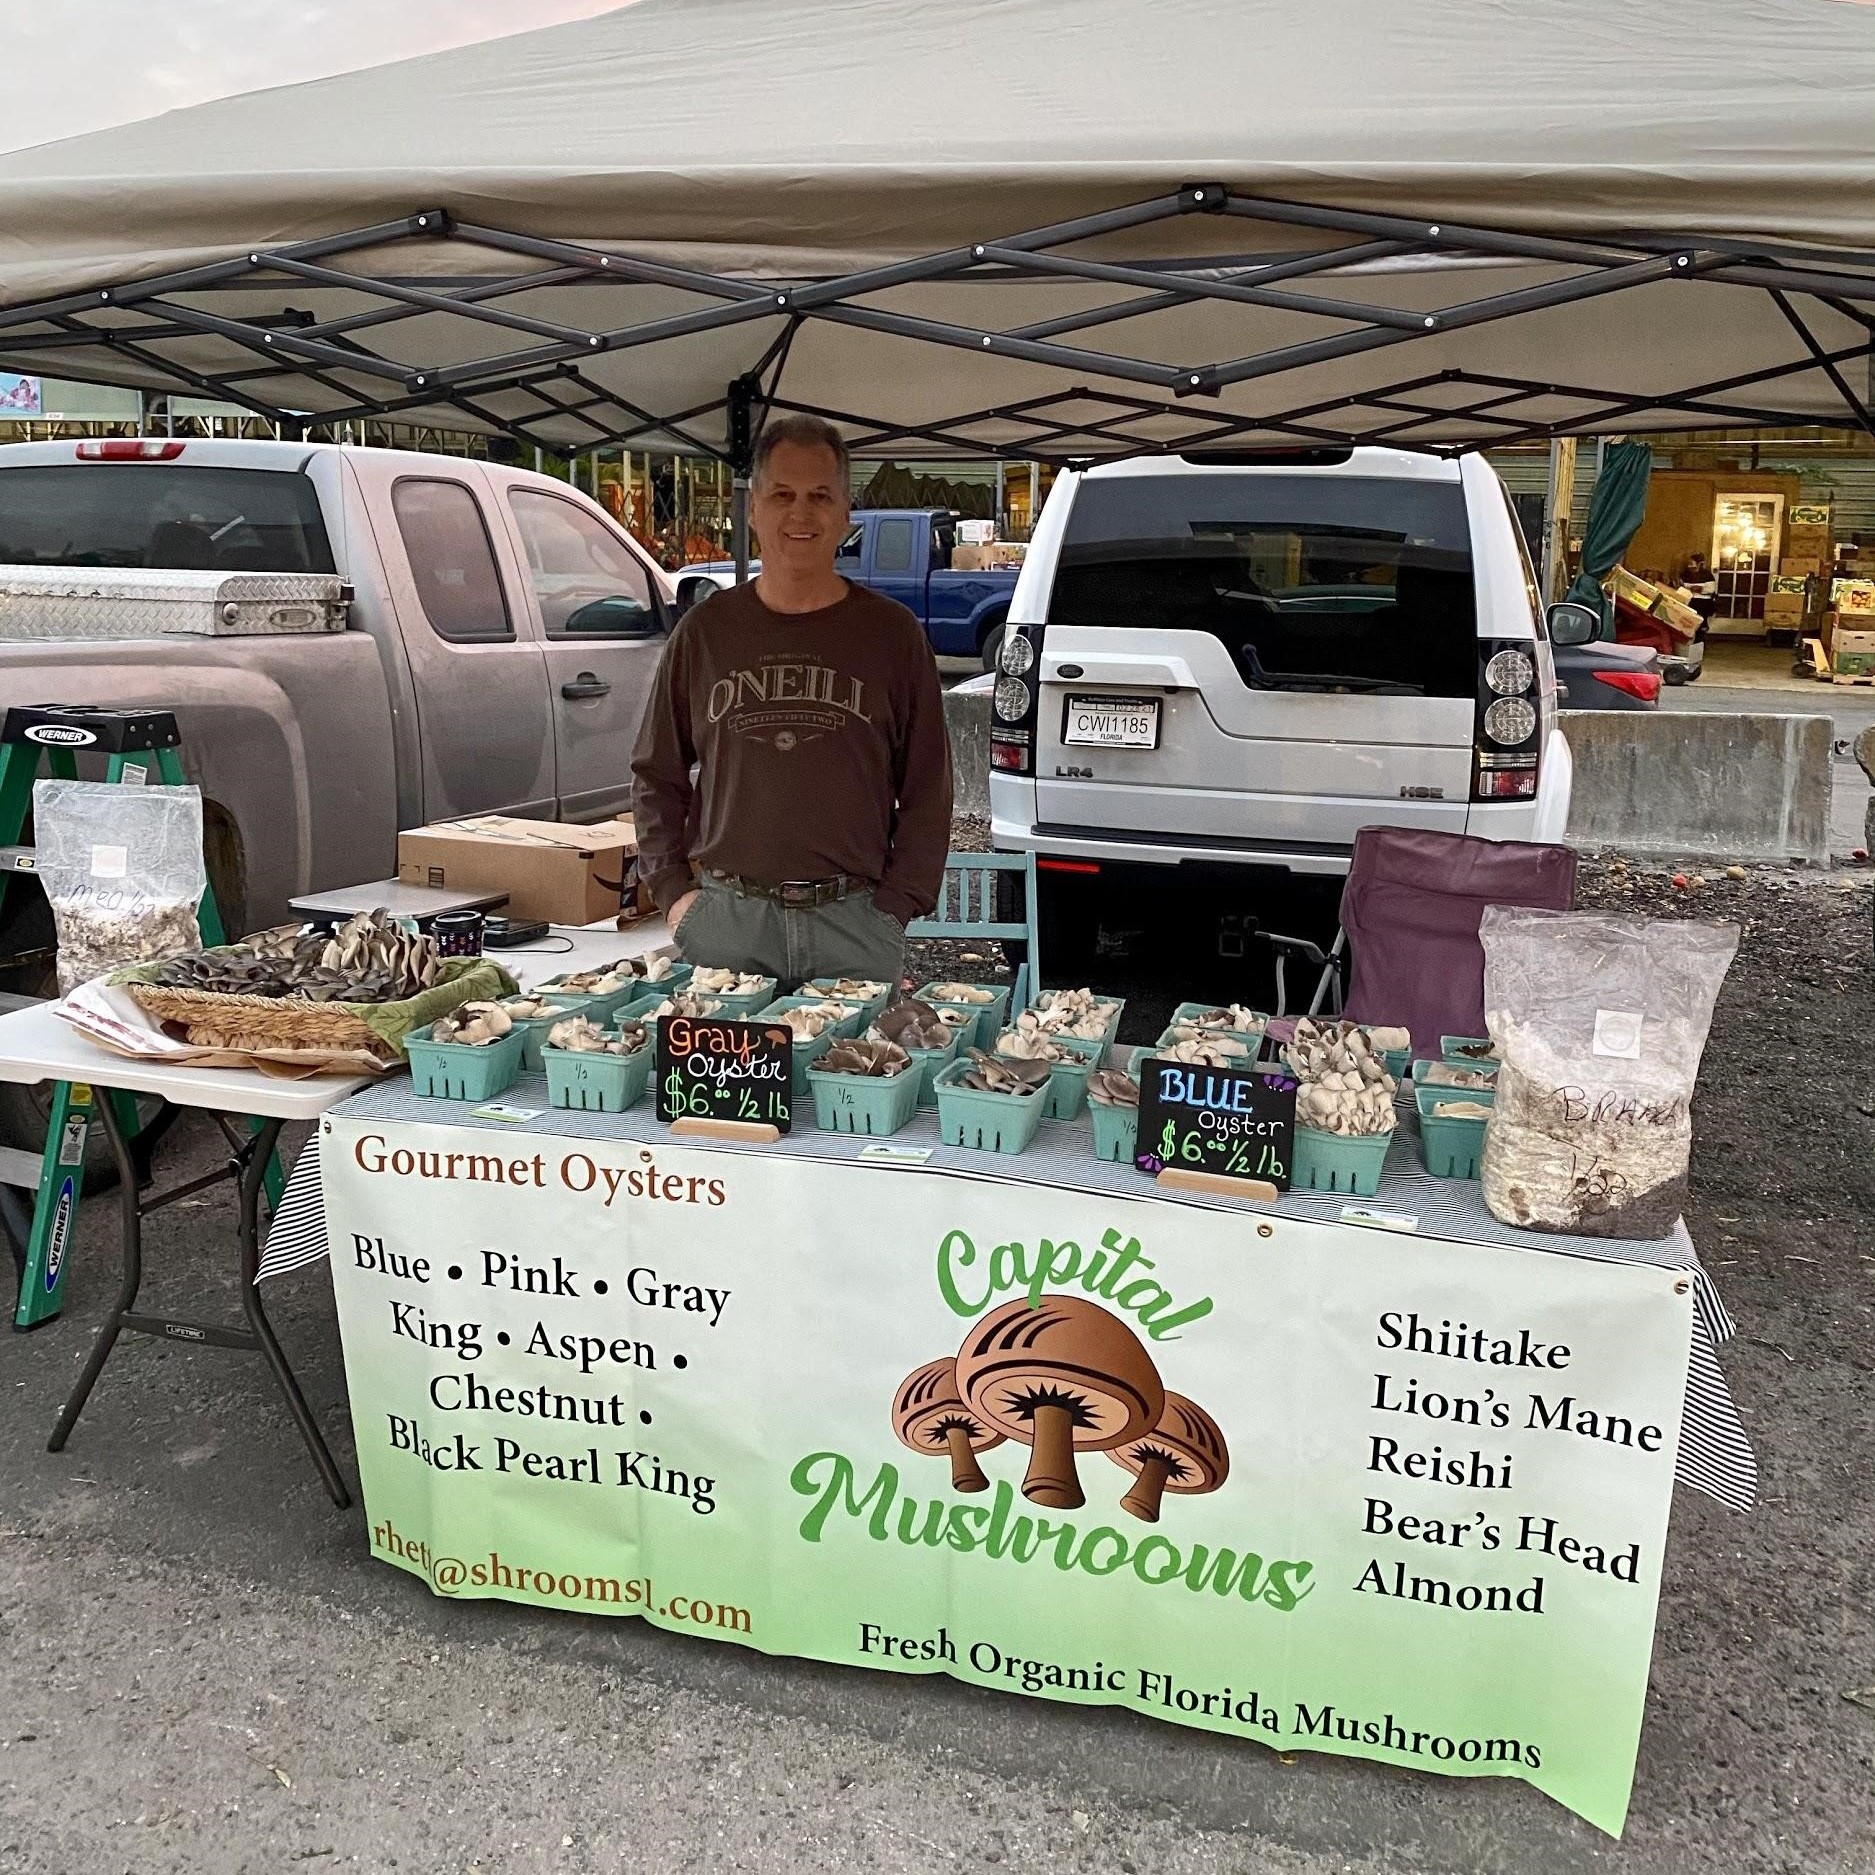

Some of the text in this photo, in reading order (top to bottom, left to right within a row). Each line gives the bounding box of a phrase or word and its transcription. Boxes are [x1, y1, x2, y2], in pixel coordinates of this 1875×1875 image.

[707, 665, 872, 724] O'NEILL
[38, 729, 83, 742] WERNER
[1078, 715, 1148, 733] CWI1185
[1056, 766, 1093, 778] LR4
[669, 1018, 760, 1066] Gray
[688, 1053, 786, 1087] Oyster
[768, 1091, 790, 1120] lb.
[1160, 1069, 1253, 1113] BLUE
[1198, 1111, 1284, 1141] Oyster
[355, 1135, 726, 1206] Gourmet Oysters
[1257, 1145, 1287, 1179] lb.
[49, 1199, 69, 1268] WERNER
[351, 1233, 731, 1326] Blue Pink Gray
[937, 1227, 1214, 1341] Capital
[389, 1300, 657, 1373] King Aspen
[1377, 1312, 1571, 1369] Shiitake
[430, 1373, 626, 1426] Chestnut
[1371, 1374, 1663, 1452] Lion’s Mane
[387, 1414, 717, 1515] Black Pearl King
[1367, 1435, 1513, 1488] Reishi
[790, 1451, 1315, 1612] Mushrooms
[1361, 1498, 1640, 1584] Bear’s Head
[1353, 1559, 1545, 1614] Almond
[859, 1623, 1542, 1769] Fresh Organic Florida Mushrooms
